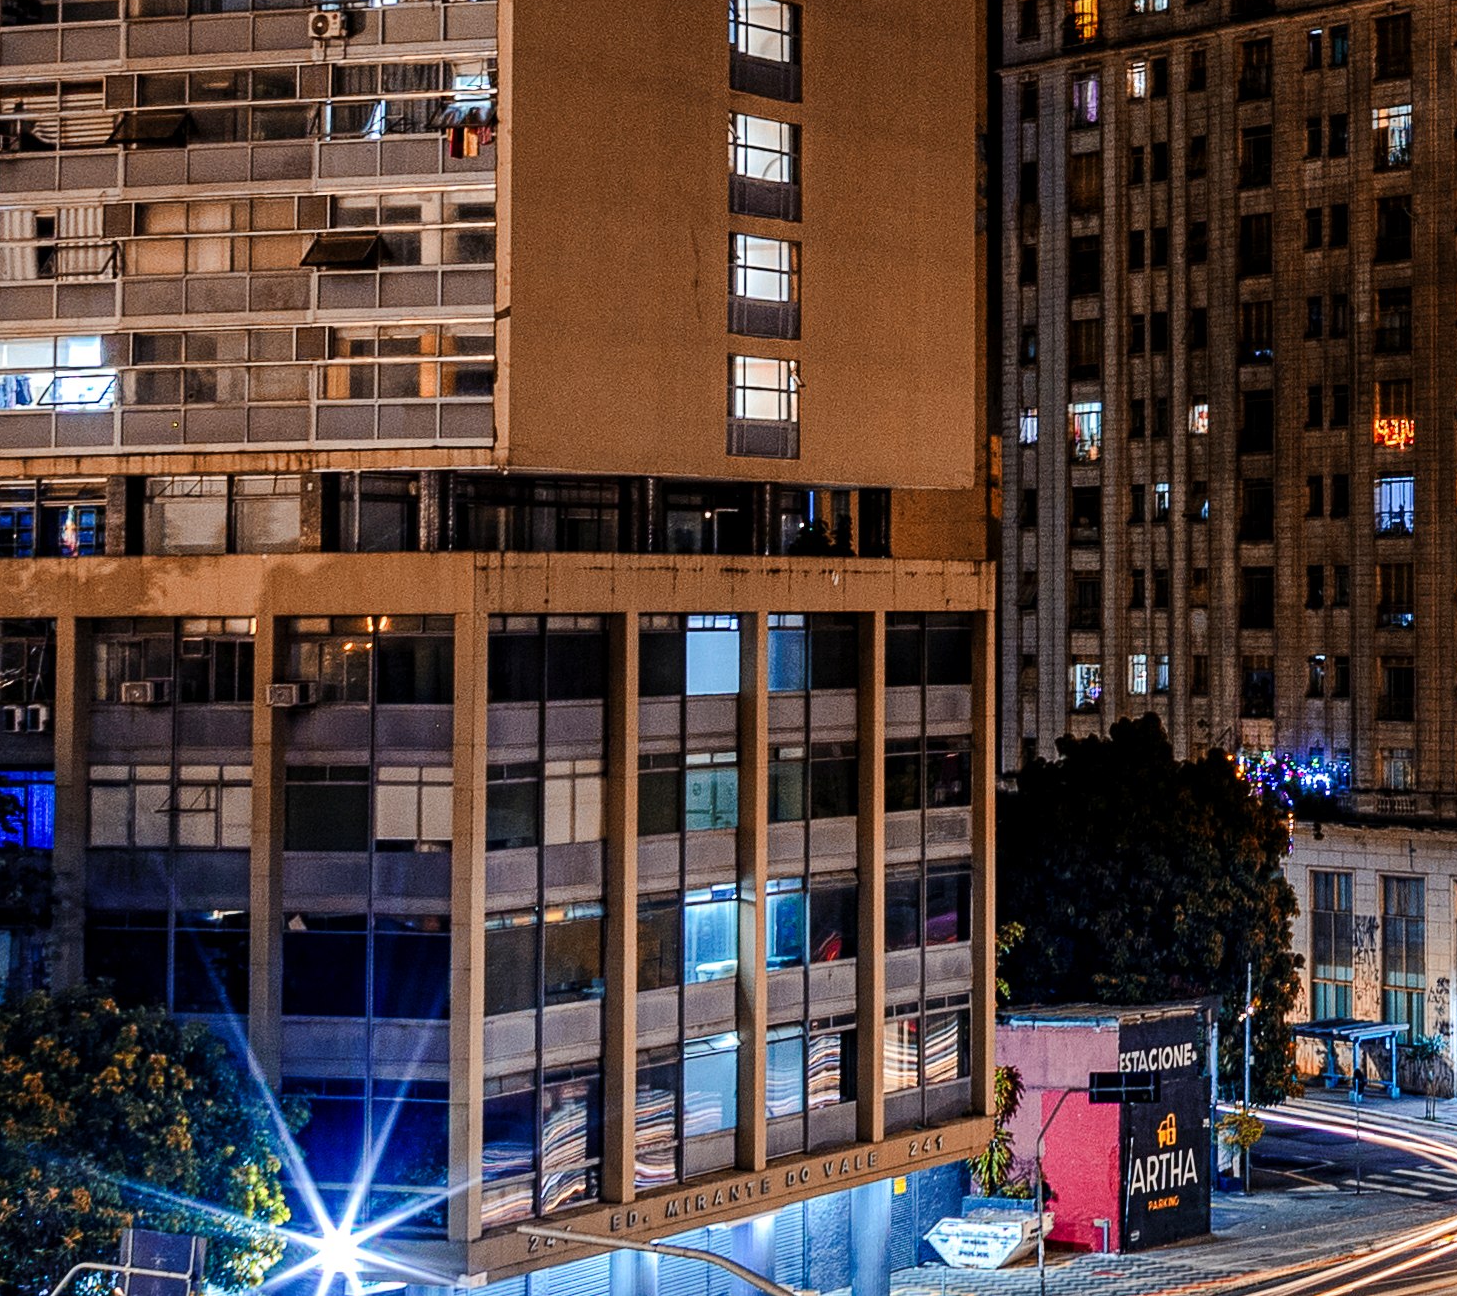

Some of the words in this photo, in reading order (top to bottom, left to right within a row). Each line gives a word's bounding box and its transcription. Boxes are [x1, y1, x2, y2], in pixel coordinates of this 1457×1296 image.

[1119, 1042, 1193, 1073] ESTACIONE
[665, 1178, 770, 1218] MIRANTE
[786, 1166, 810, 1187] DO
[823, 1151, 878, 1178] VALE
[909, 1135, 944, 1157] 241
[1130, 1147, 1199, 1196] ARTHA
[1147, 1195, 1180, 1212] PARKING
